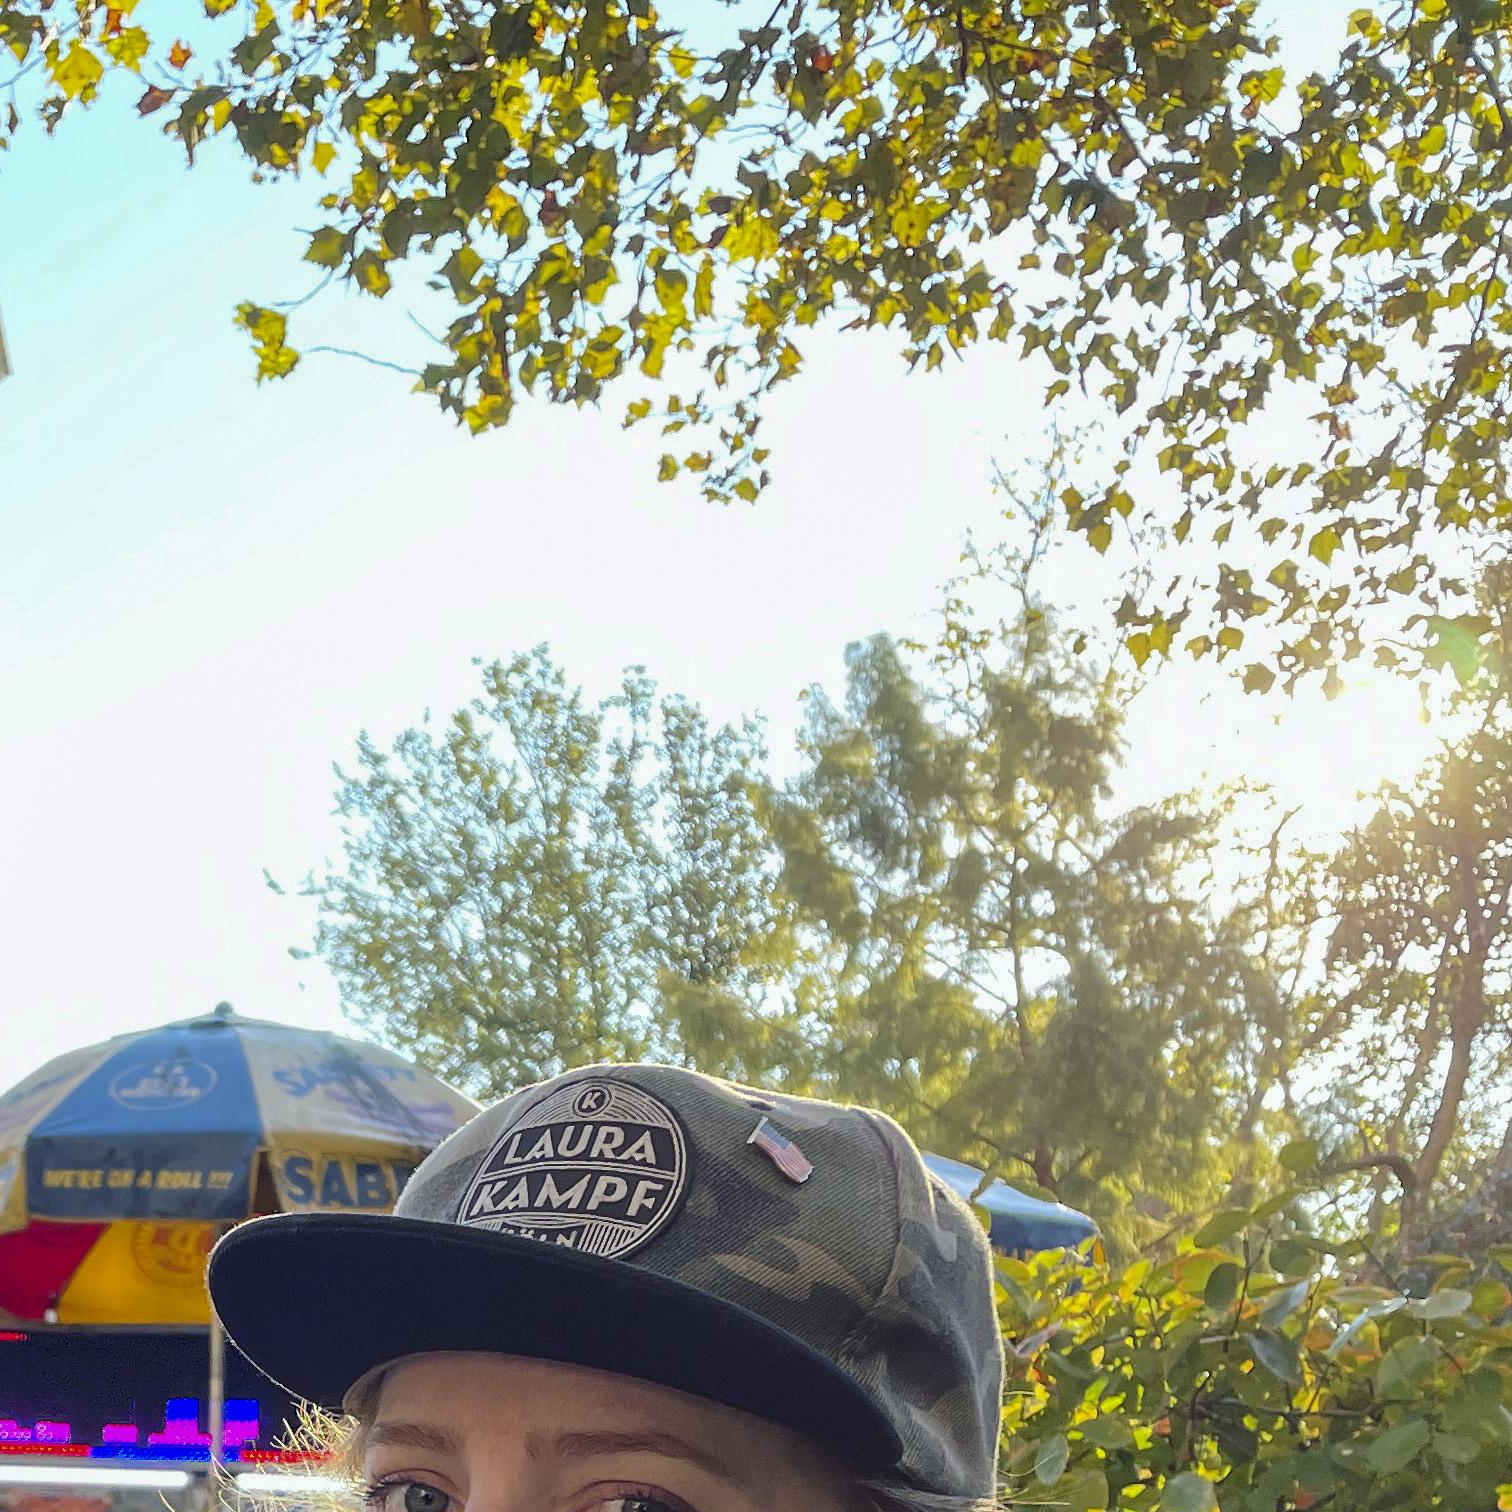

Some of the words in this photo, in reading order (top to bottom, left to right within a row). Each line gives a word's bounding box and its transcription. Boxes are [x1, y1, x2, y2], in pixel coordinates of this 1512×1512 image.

[581, 1091, 602, 1110] K
[503, 1125, 657, 1166] LAURA
[469, 1173, 664, 1218] KAMPF
